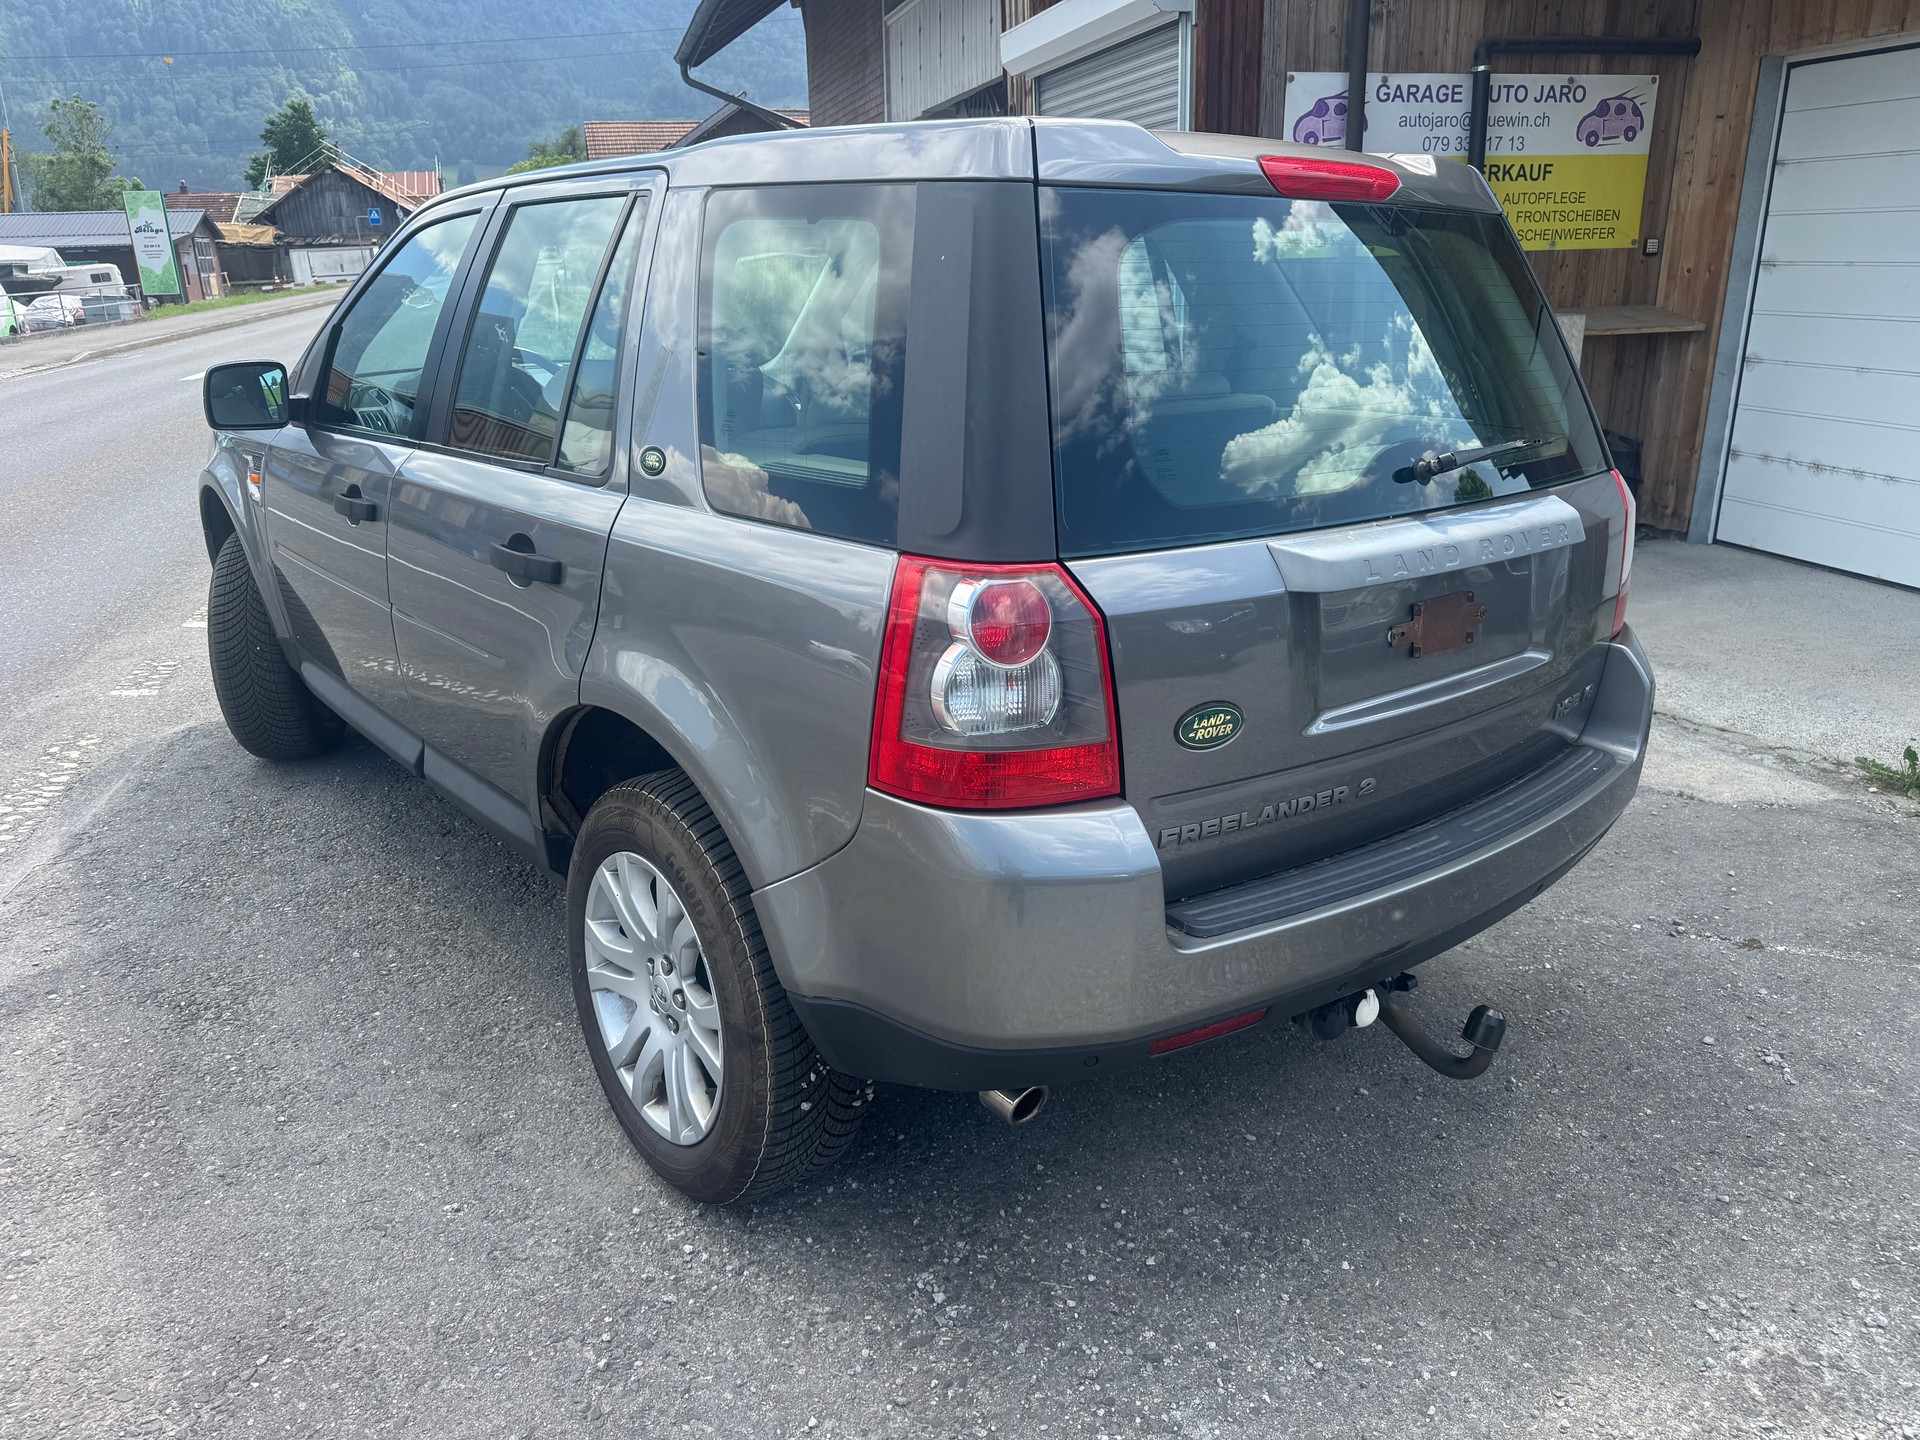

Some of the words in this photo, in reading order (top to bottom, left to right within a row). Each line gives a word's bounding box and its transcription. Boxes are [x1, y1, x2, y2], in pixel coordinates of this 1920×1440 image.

[1375, 84, 1463, 104] GARAGE
[1488, 84, 1529, 104] UTO
[1533, 84, 1587, 104] JARO
[1422, 136, 1450, 152] 079
[1486, 136, 1503, 151] 17
[1508, 136, 1525, 151] 13
[1502, 191, 1586, 205] AUTOPFLEGE
[1516, 209, 1621, 223] FRONTSCHEIBEN
[1516, 227, 1615, 242] SCHEINWERFER
[1363, 545, 1460, 581] LAND
[1478, 523, 1569, 560] ROVER
[1157, 785, 1349, 849] FREELANDER
[1356, 777, 1377, 798] 2
